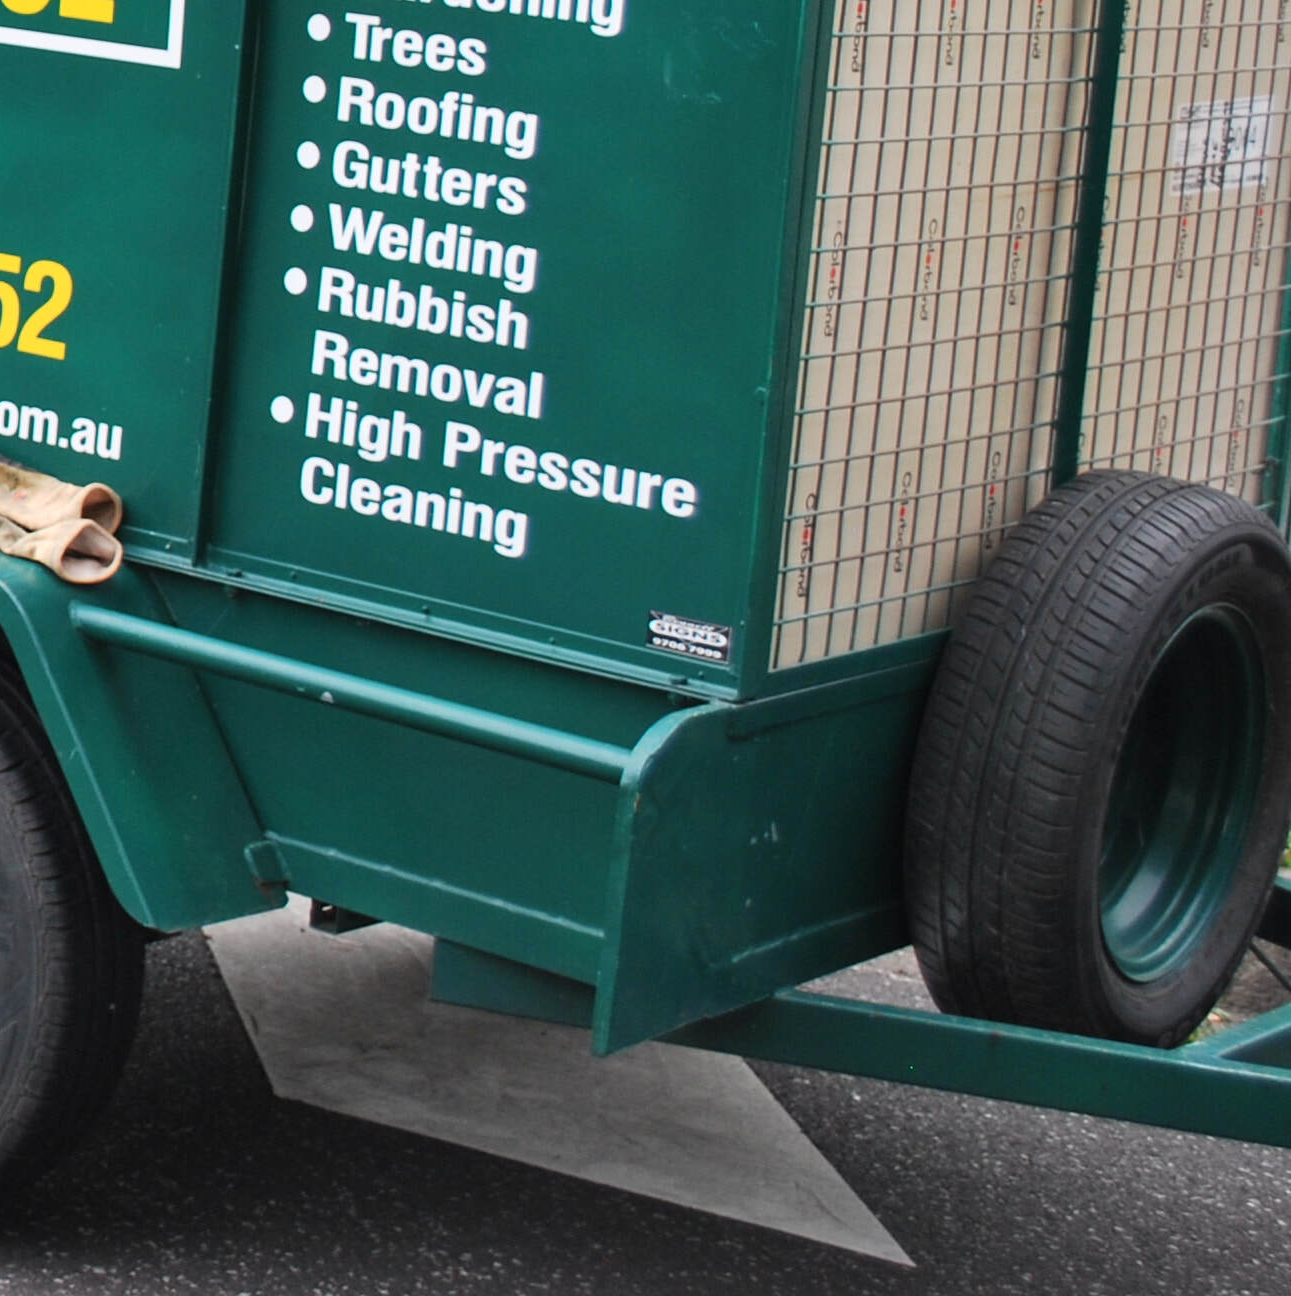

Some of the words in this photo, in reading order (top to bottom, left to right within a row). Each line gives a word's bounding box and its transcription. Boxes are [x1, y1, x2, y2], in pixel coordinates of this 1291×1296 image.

[346, 13, 487, 75] Trees
[338, 76, 539, 160] Roofing
[333, 140, 528, 215] Gutters
[329, 203, 538, 294] Welding
[318, 267, 529, 349] Rubbish
[312, 330, 544, 419] Removal
[306, 393, 422, 462] High
[443, 421, 697, 518] Pressure
[300, 457, 528, 558] Cleaning
